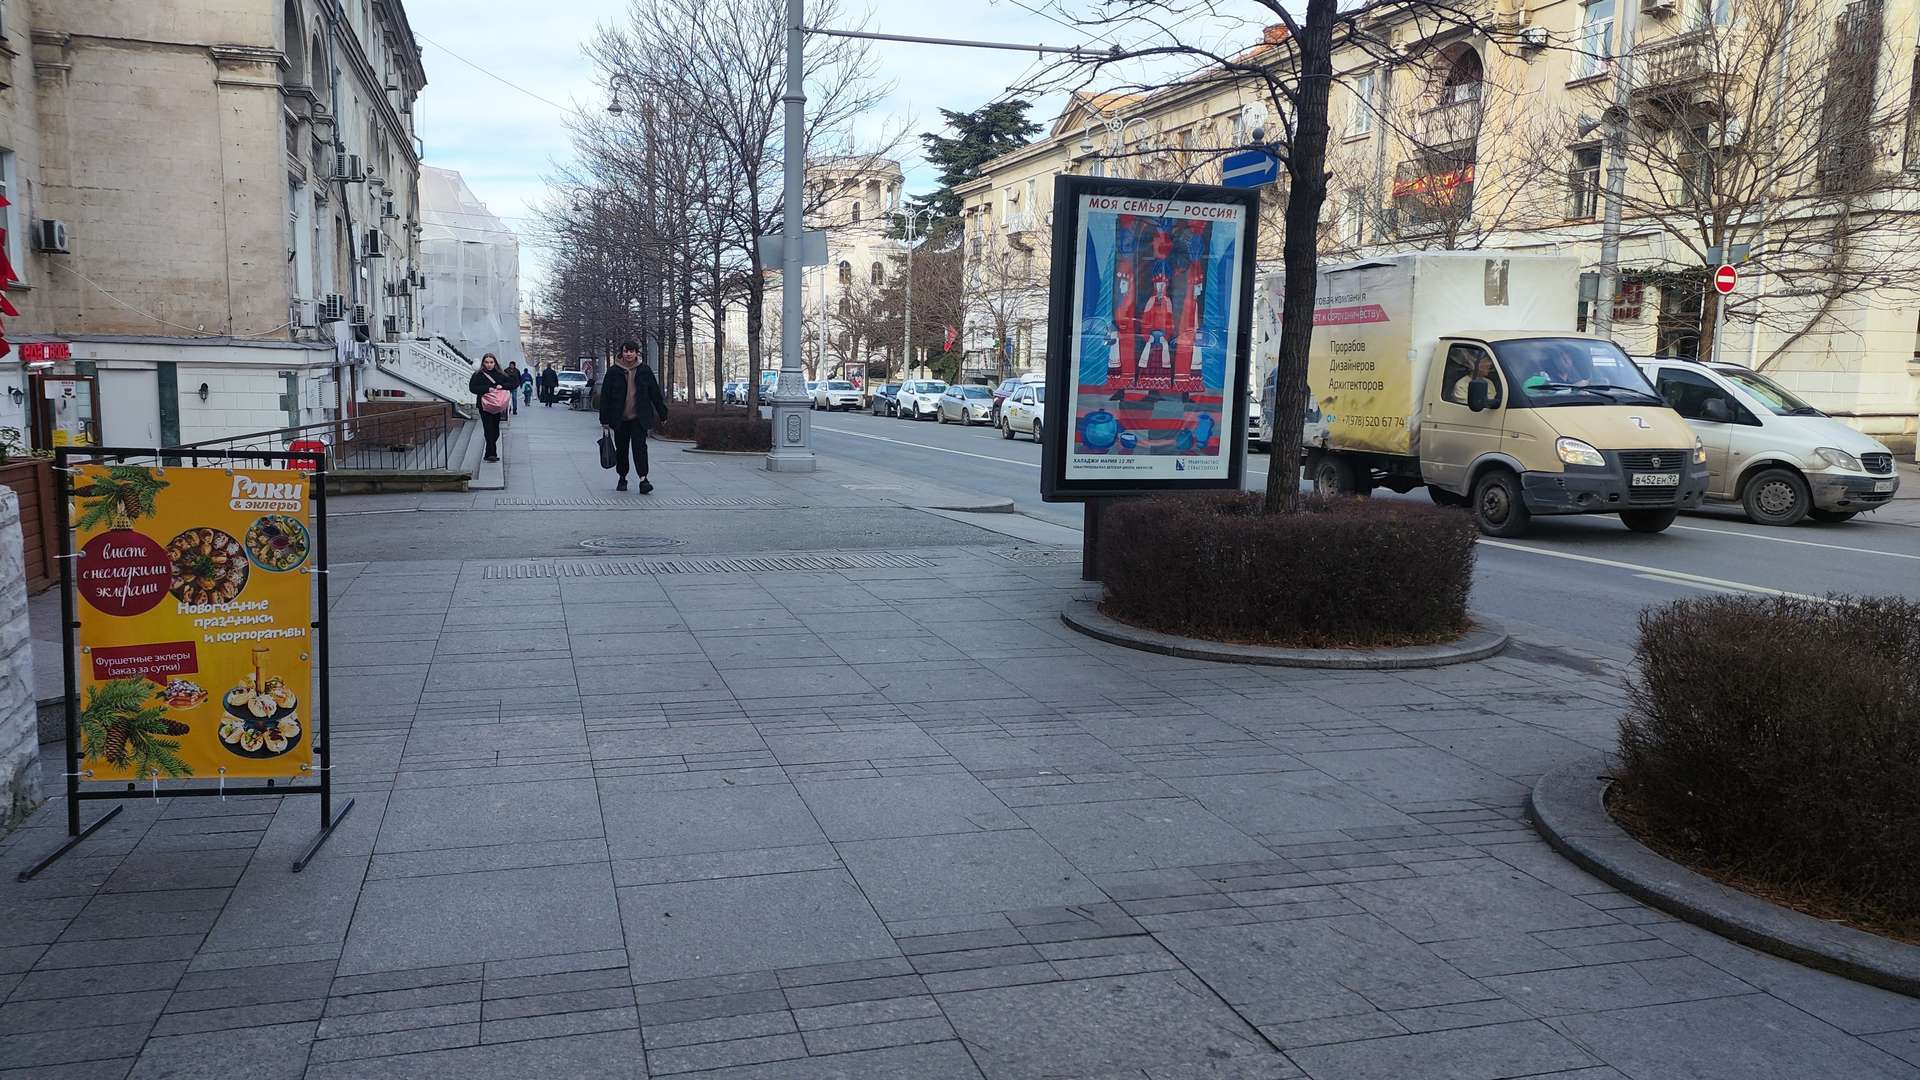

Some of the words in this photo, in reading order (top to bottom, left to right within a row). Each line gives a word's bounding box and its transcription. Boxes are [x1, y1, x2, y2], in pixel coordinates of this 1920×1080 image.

[1089, 198, 1118, 209] МОЯ
[1123, 200, 1163, 213] СЕМЬЯ
[1184, 205, 1237, 219] РОССИЯ!
[1330, 340, 1366, 355] Прорабов
[1329, 360, 1375, 374] Дизайнеров
[1328, 378, 1384, 392] Архитекторов
[1382, 417, 1392, 428] 67
[1394, 417, 1405, 427] 74
[231, 475, 303, 499] Раки
[233, 501, 242, 509] &
[245, 501, 298, 511] эклеры
[102, 543, 148, 560] вместе
[82, 570, 90, 579] с
[91, 565, 168, 587] несладкими
[96, 583, 158, 607] эклерами
[177, 600, 269, 615] Новогодние
[194, 614, 274, 629] праздники
[203, 634, 214, 643] и
[217, 628, 306, 643] корпоративы
[95, 656, 153, 667] Фуршетные
[154, 652, 191, 663] эклеры
[107, 667, 137, 676] (заказ
[150, 663, 181, 674] сутки)
